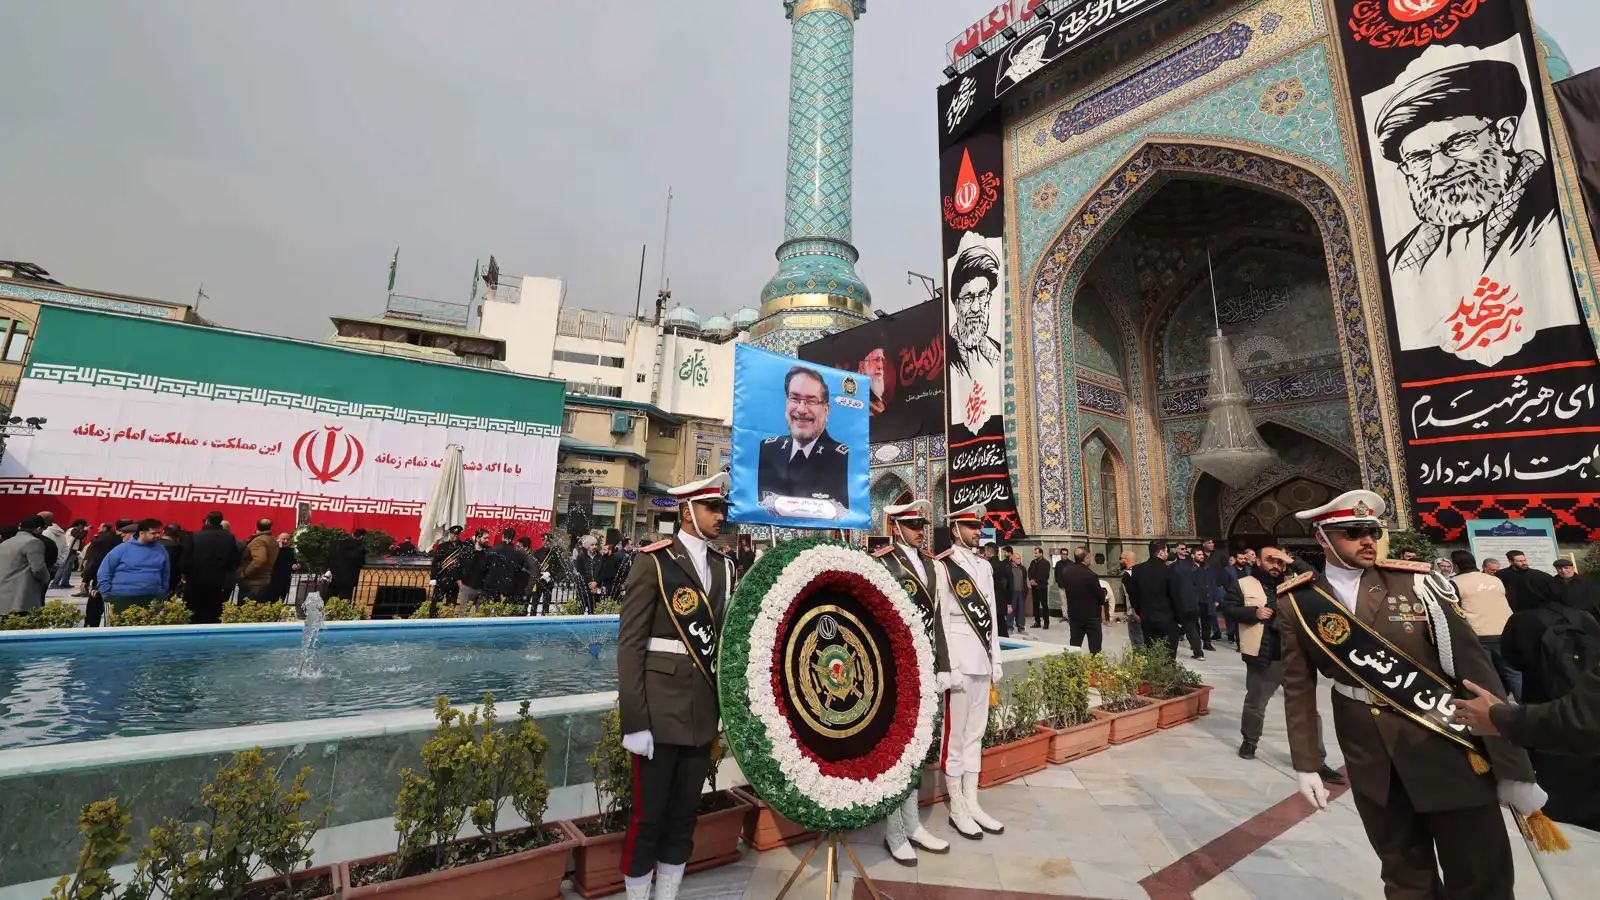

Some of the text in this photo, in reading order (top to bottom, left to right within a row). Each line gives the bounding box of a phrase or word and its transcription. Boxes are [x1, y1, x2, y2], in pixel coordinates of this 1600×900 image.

[1411, 375, 1595, 439] ای رهبر شهیدم
[72, 421, 111, 443] زمانه
[113, 426, 147, 443] امام
[148, 431, 199, 447] مملکت
[211, 437, 257, 451] مملکت
[258, 441, 282, 456] این
[374, 452, 402, 470] زمانه
[404, 455, 428, 469] تمام
[463, 460, 483, 471] دشم
[503, 463, 513, 474] ما
[1454, 453, 1511, 485] ادامه
[515, 463, 522, 477] با
[1419, 456, 1454, 485] دارد
[967, 601, 991, 628] ارتش
[688, 621, 716, 657] ارتش
[1348, 648, 1419, 690] ارتش
